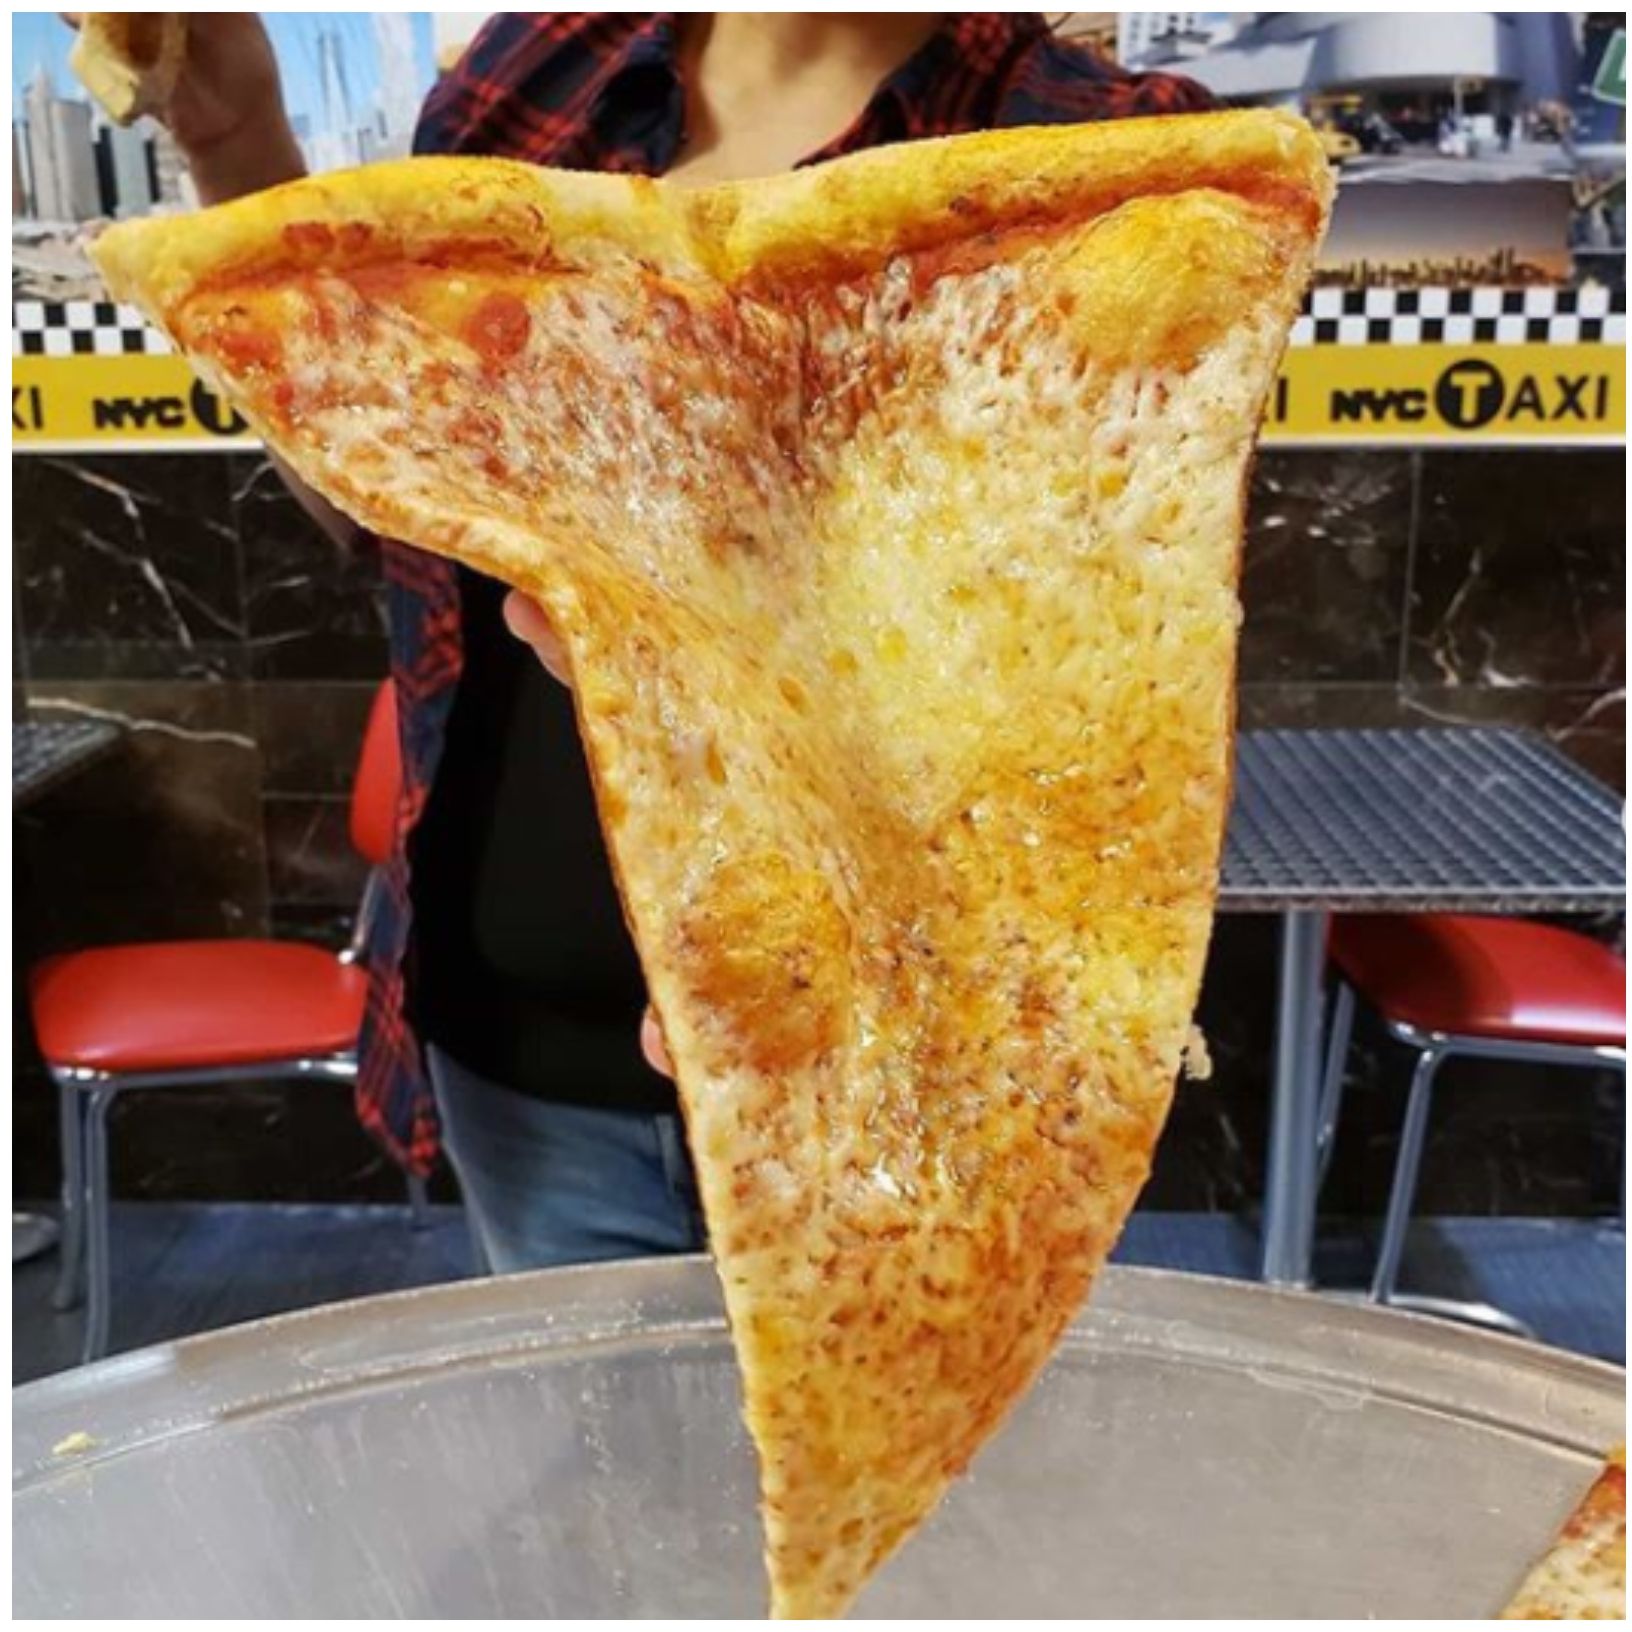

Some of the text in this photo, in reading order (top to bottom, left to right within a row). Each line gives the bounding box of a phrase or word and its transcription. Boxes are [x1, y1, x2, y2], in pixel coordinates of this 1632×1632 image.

[92, 396, 186, 430] NYC
[1330, 390, 1428, 422] NYC
[1436, 359, 1609, 430] TAXI
